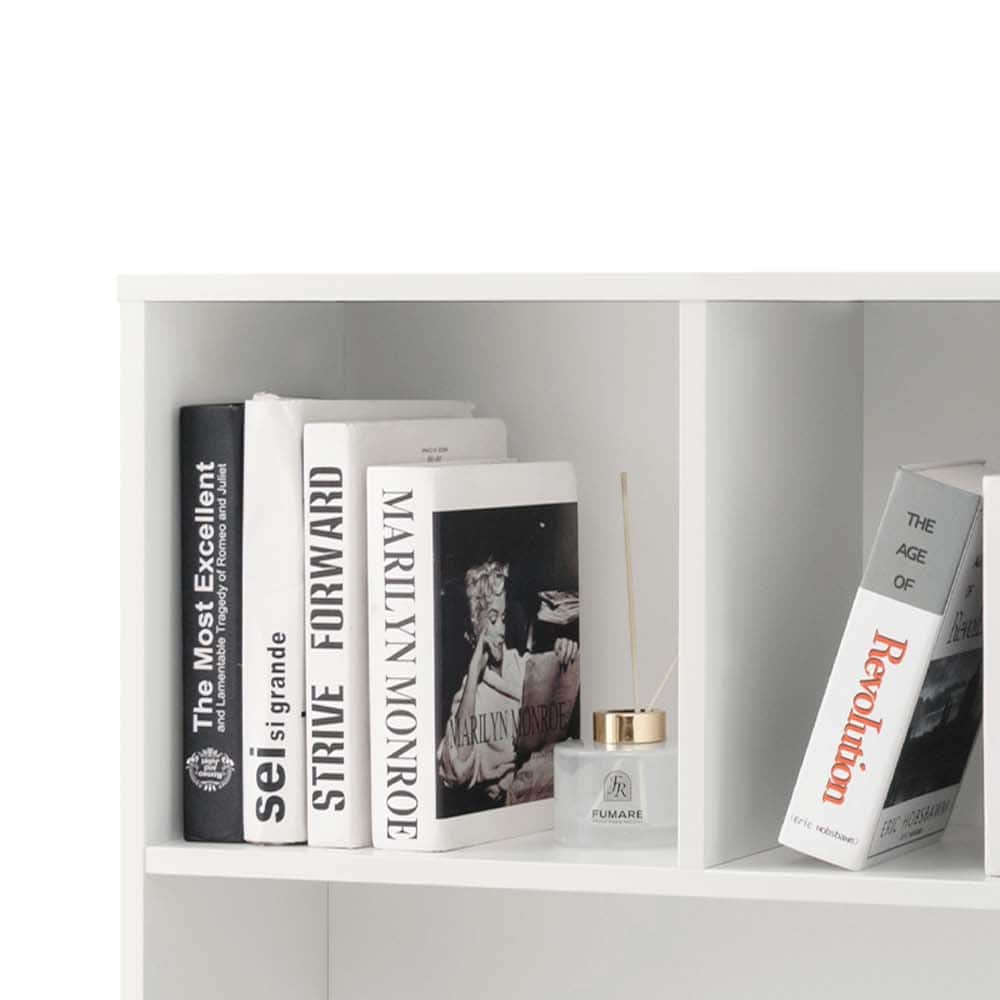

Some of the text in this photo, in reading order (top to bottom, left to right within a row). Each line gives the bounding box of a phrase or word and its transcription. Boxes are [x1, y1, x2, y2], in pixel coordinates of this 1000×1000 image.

[193, 461, 215, 593] Excellent
[895, 543, 928, 565] AGE
[907, 511, 937, 535] THE
[215, 463, 229, 733] and Lamentable Tragedy of Romeo and Juliet
[893, 574, 916, 591] OF
[192, 600, 214, 671] Most
[309, 466, 345, 812] STRIVE FORWARD
[381, 488, 419, 841] MARILYN MONROE
[192, 680, 213, 733] The
[265, 632, 290, 741] si grande
[822, 628, 908, 807] Revolution
[449, 701, 568, 749] MARILYN MONROE
[249, 747, 286, 824] sei
[592, 809, 644, 819] FUMARE
